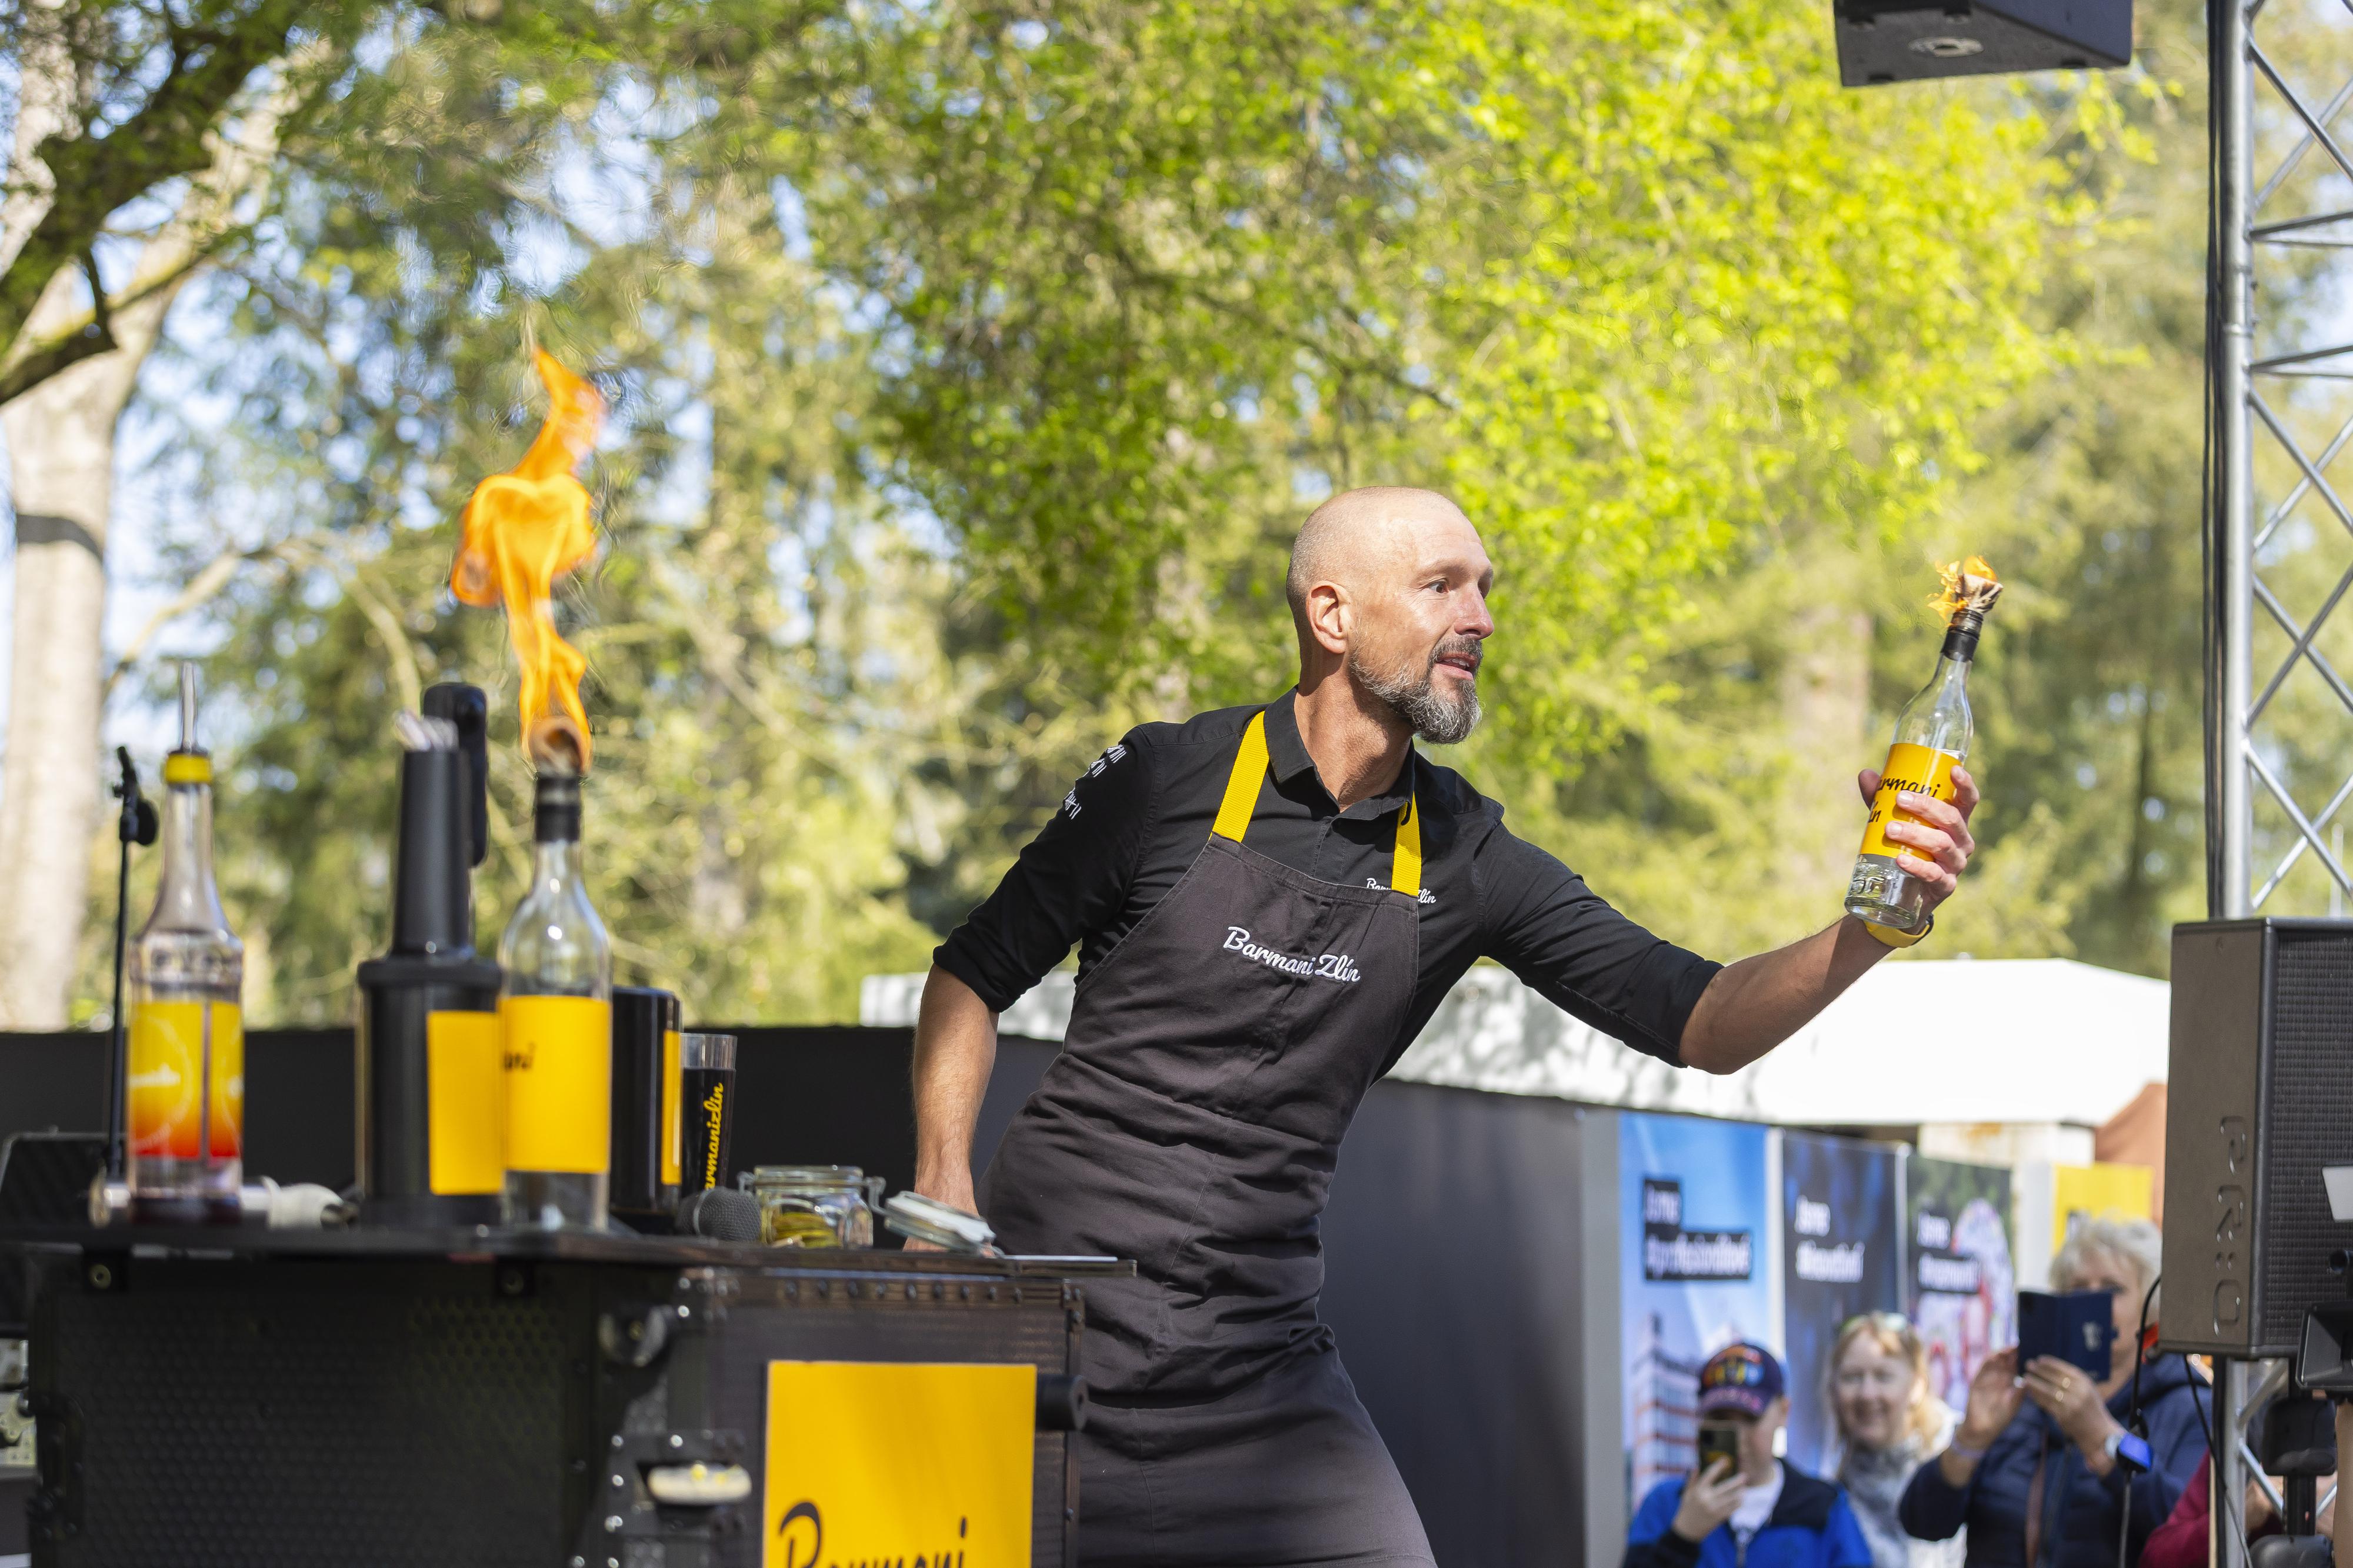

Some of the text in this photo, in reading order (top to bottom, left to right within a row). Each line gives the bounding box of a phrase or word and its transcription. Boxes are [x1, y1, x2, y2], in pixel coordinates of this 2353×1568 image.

[1417, 888, 1437, 904] lín
[1223, 926, 1361, 982] Barmani Zlín
[703, 1082, 724, 1190] armanizlin
